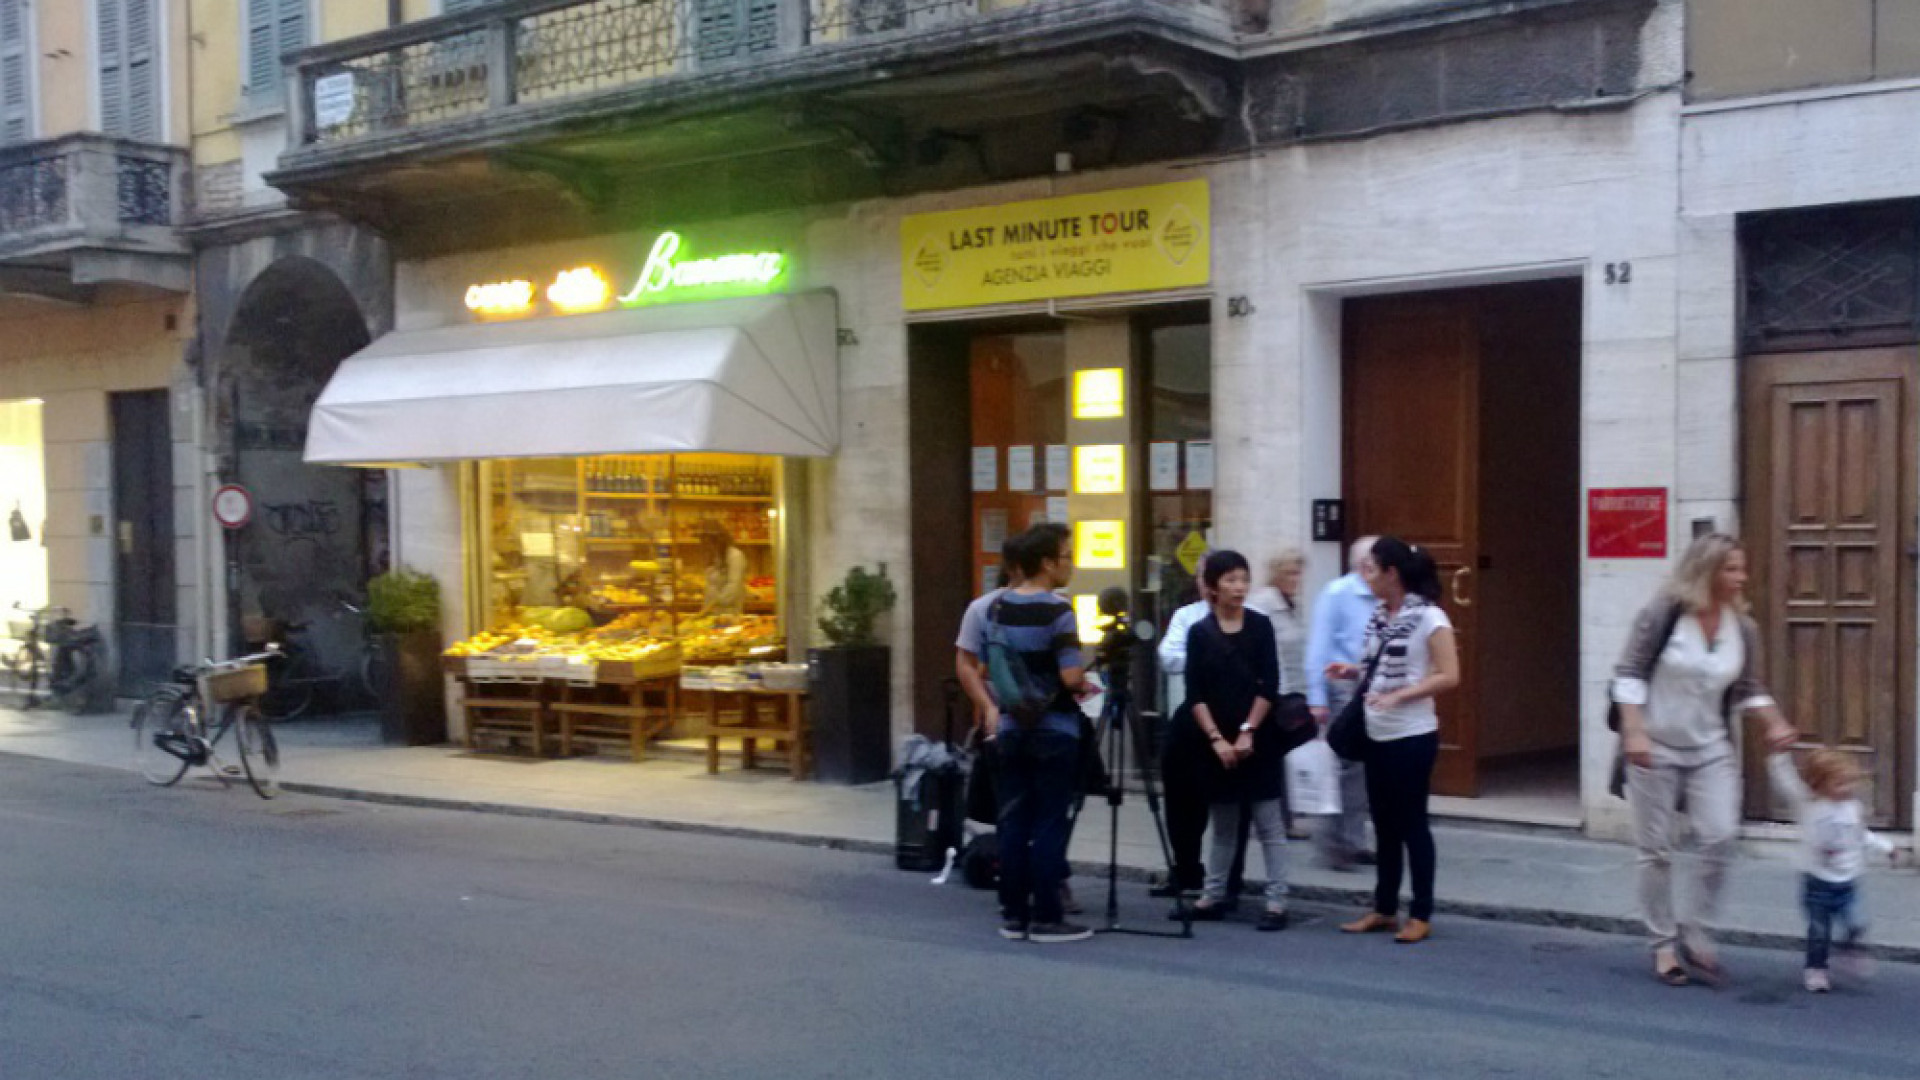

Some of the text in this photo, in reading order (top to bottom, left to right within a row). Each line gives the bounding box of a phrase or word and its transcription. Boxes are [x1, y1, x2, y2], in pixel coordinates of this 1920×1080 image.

[949, 226, 995, 251] LAST
[1003, 216, 1081, 245] MINUTE
[1088, 208, 1149, 235] TOUR
[982, 258, 1112, 286] AGENZIA VIAGGI
